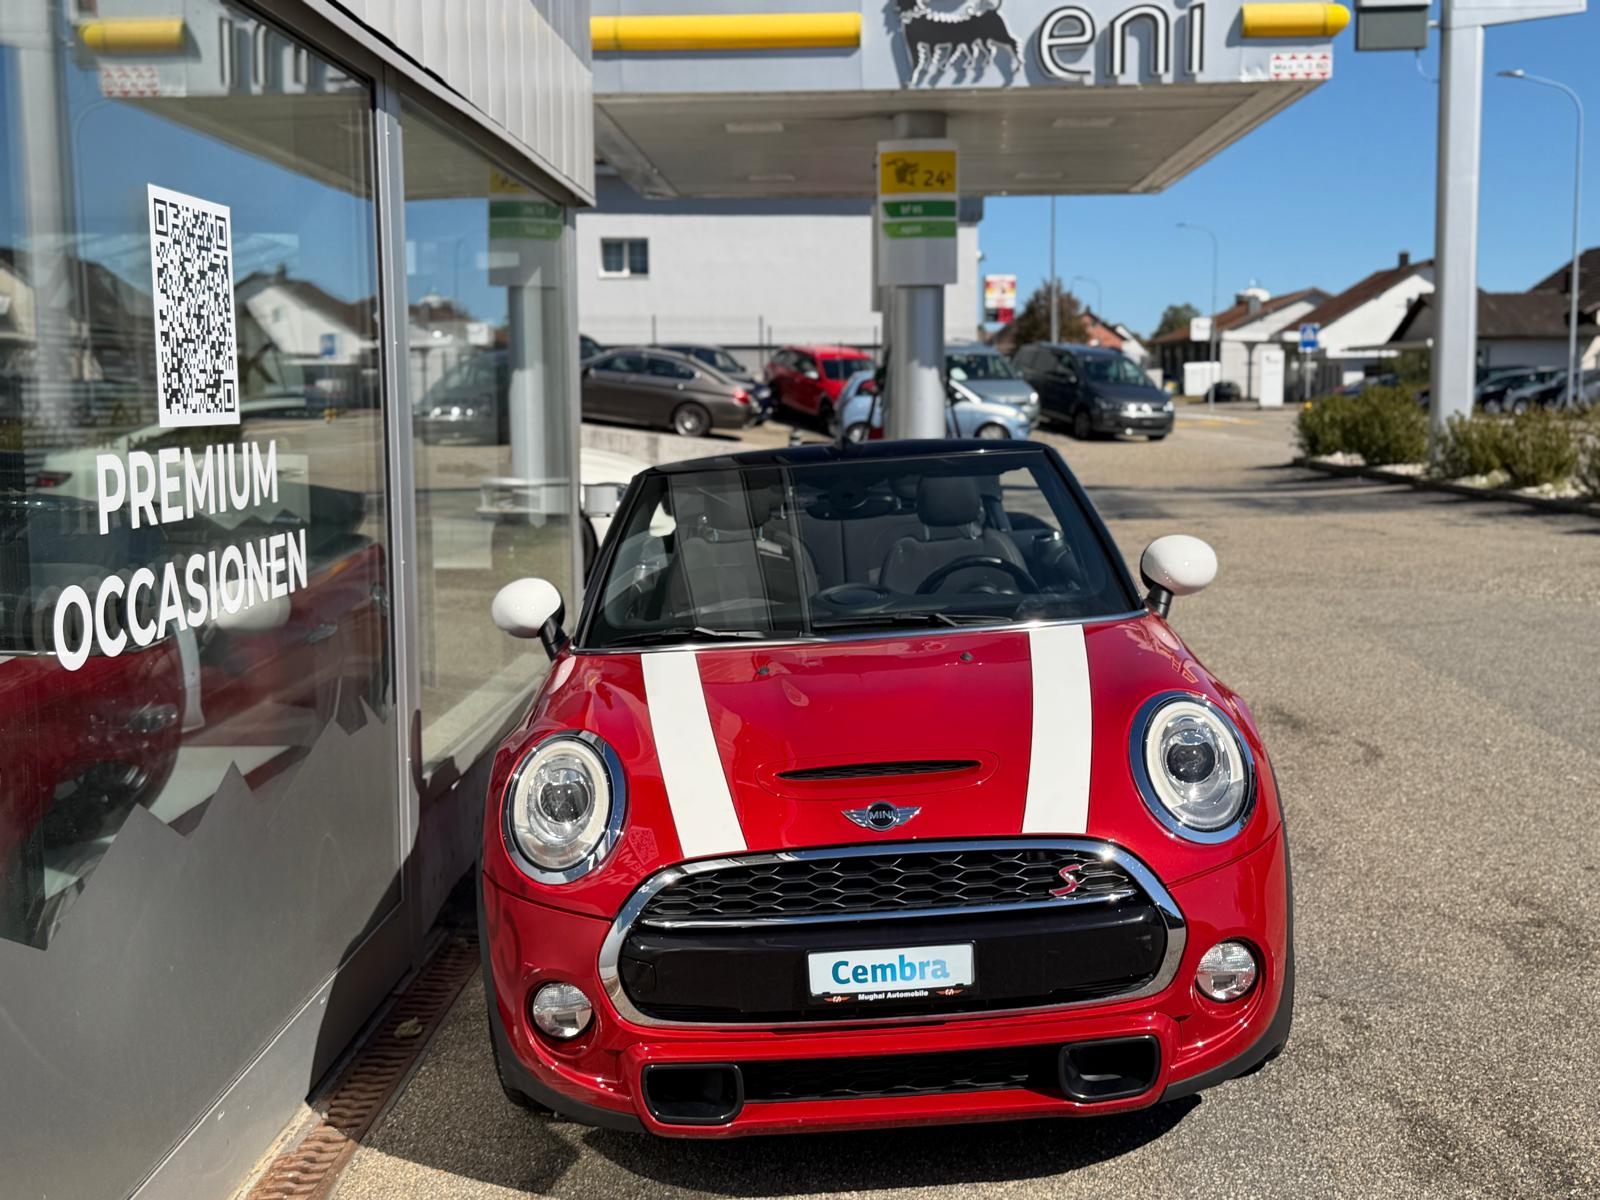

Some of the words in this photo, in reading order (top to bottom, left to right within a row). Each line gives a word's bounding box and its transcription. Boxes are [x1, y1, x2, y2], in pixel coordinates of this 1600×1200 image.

[1038, 3, 1205, 82] eni
[96, 439, 279, 535] PREMIUM
[53, 528, 308, 671] OCCASIONEN
[869, 810, 895, 820] MINI
[1049, 864, 1082, 897] S
[831, 954, 950, 985] Cembra
[857, 991, 885, 1001] Mughal
[886, 989, 929, 999] Automobile
